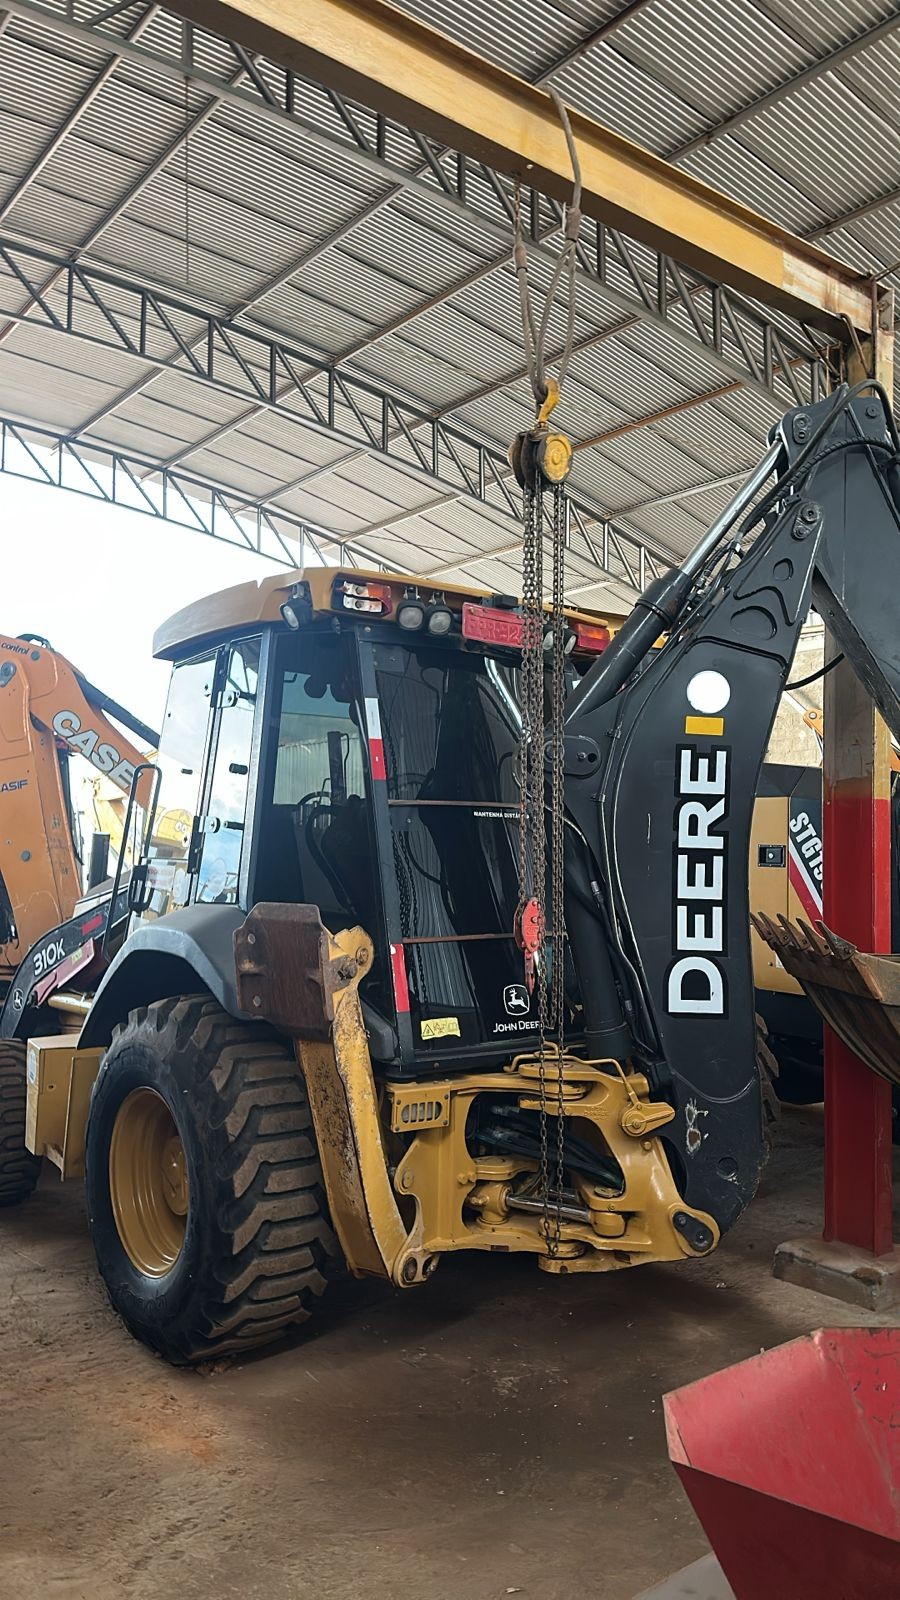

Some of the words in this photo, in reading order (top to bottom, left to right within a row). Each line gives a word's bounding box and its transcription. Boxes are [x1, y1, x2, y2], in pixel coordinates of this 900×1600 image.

[1, 642, 30, 654] control
[52, 710, 143, 790] CASE
[668, 750, 728, 1014] DEERE
[33, 937, 66, 976] 310K
[493, 1022, 517, 1033] JOHN
[518, 1020, 542, 1030] DEER
